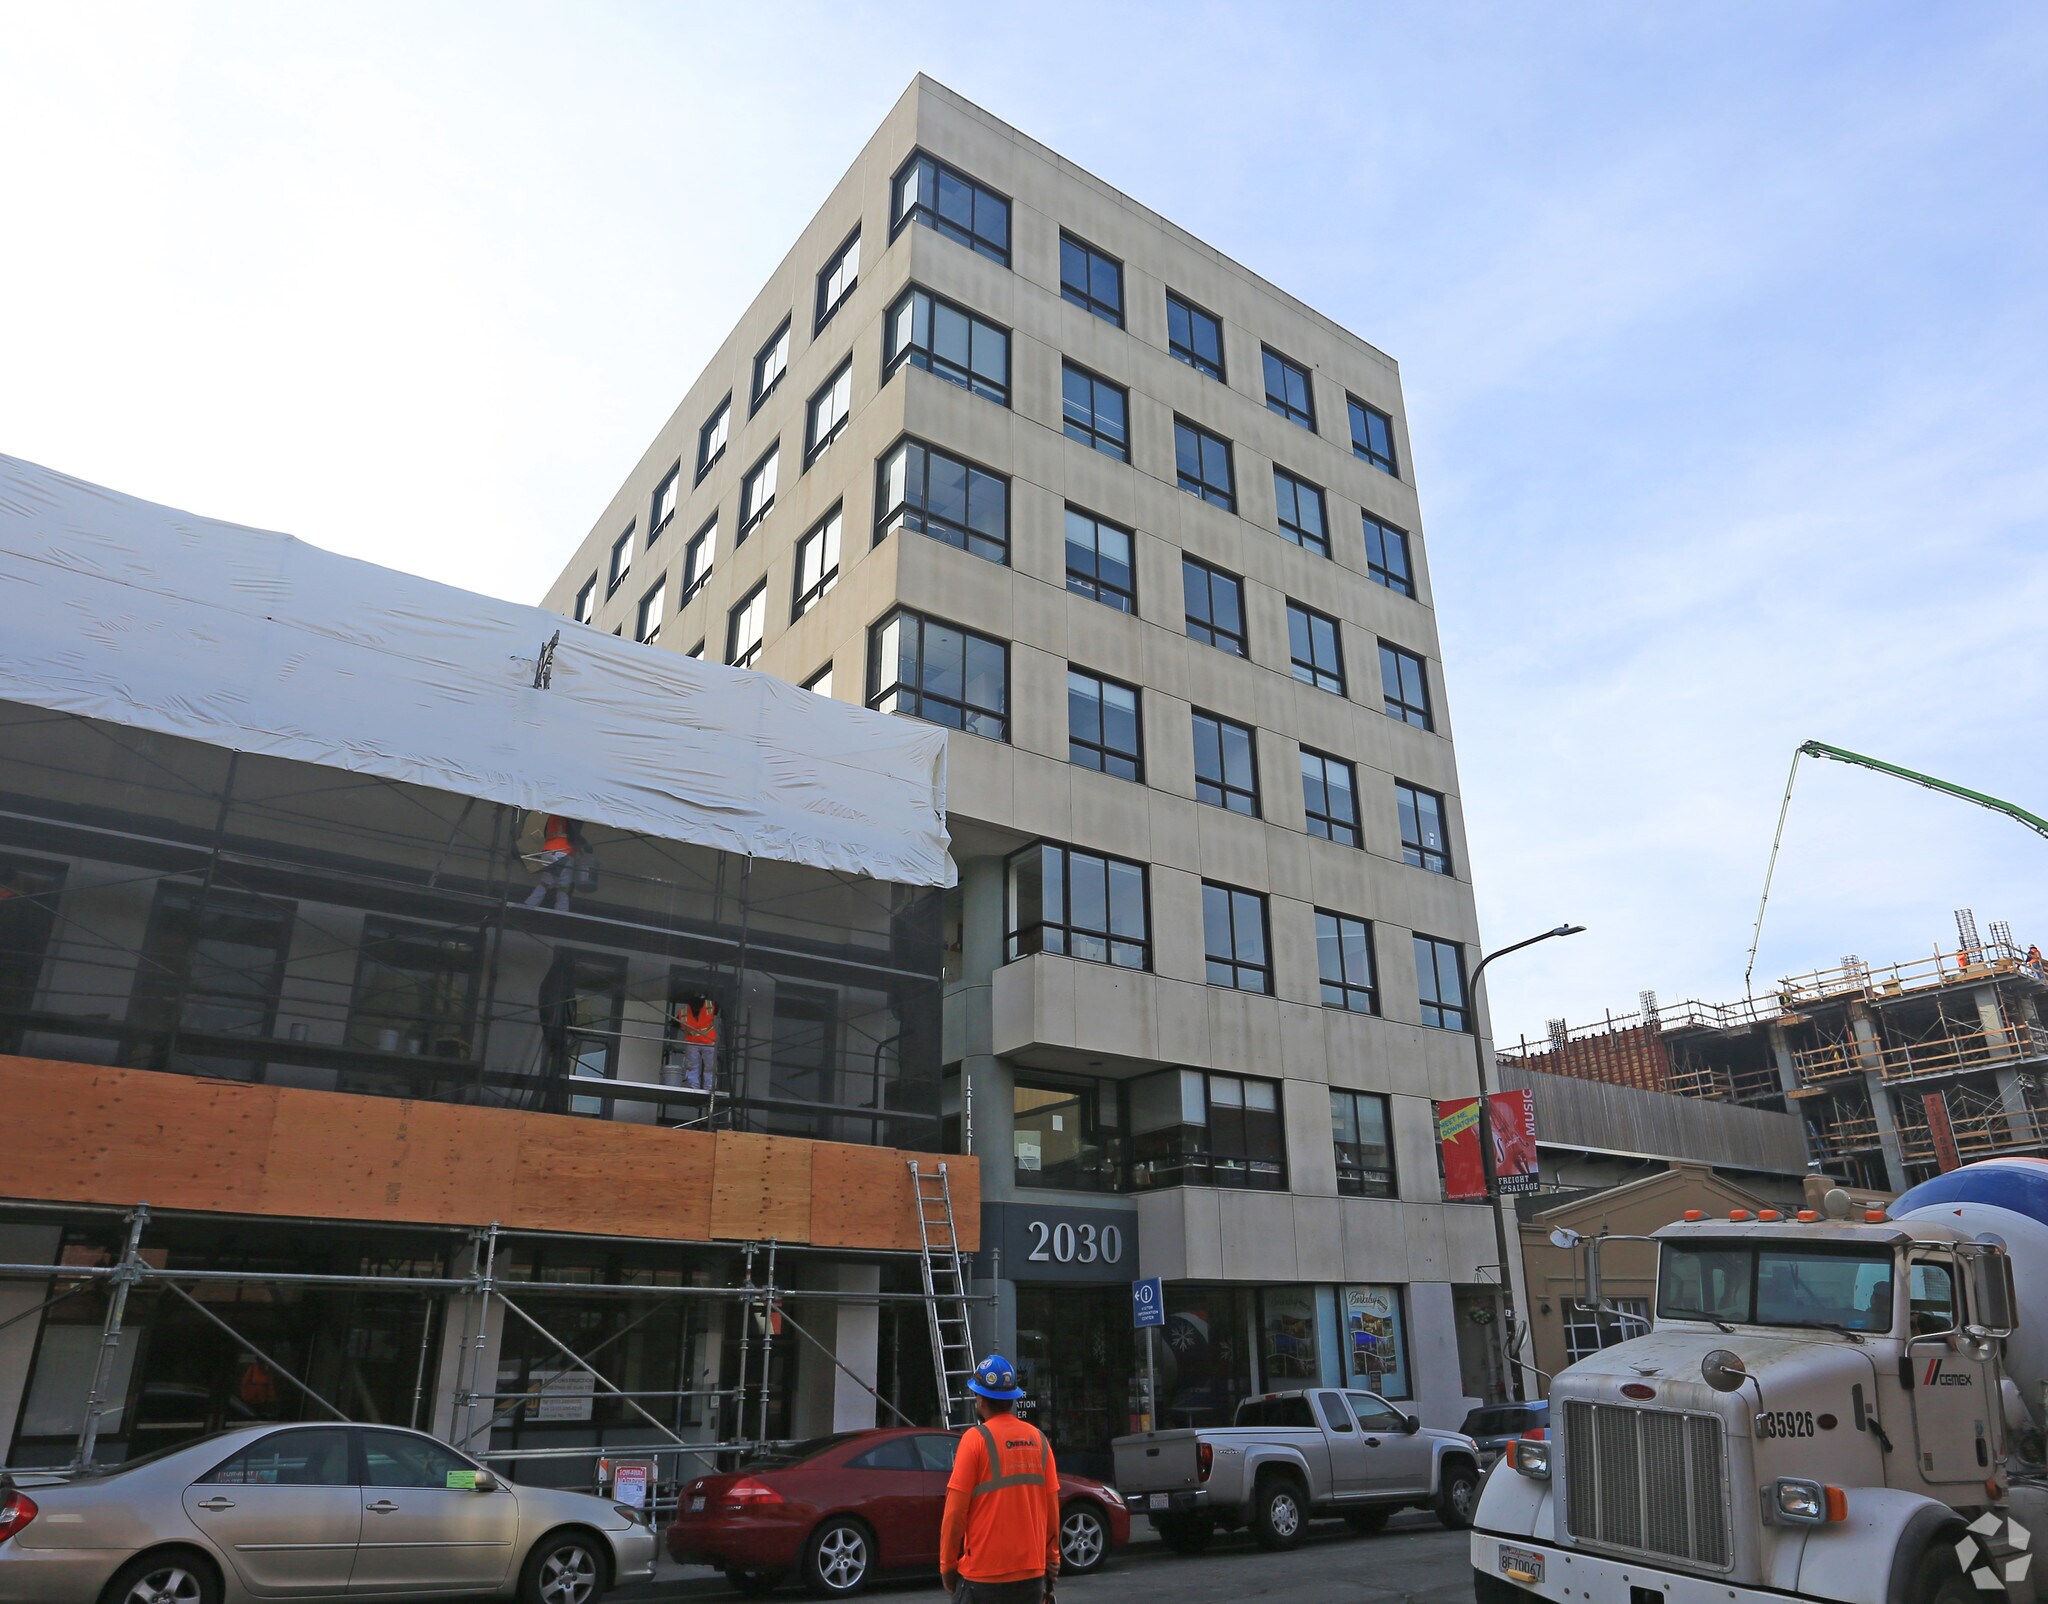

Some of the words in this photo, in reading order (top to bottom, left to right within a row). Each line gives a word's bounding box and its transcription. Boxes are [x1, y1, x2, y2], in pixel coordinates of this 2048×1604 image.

[1440, 1115, 1455, 1128] MEET
[1457, 1112, 1467, 1121] ME
[1522, 1089, 1535, 1136] MUSIC
[1442, 1114, 1480, 1137] DOWNTOWN
[1498, 1175, 1529, 1185] FREIGHT
[1507, 1182, 1538, 1193] SALVAGE
[1028, 1221, 1122, 1263] 2030
[1940, 1374, 1972, 1386] CEMEX
[1767, 1411, 1814, 1438] 35926
